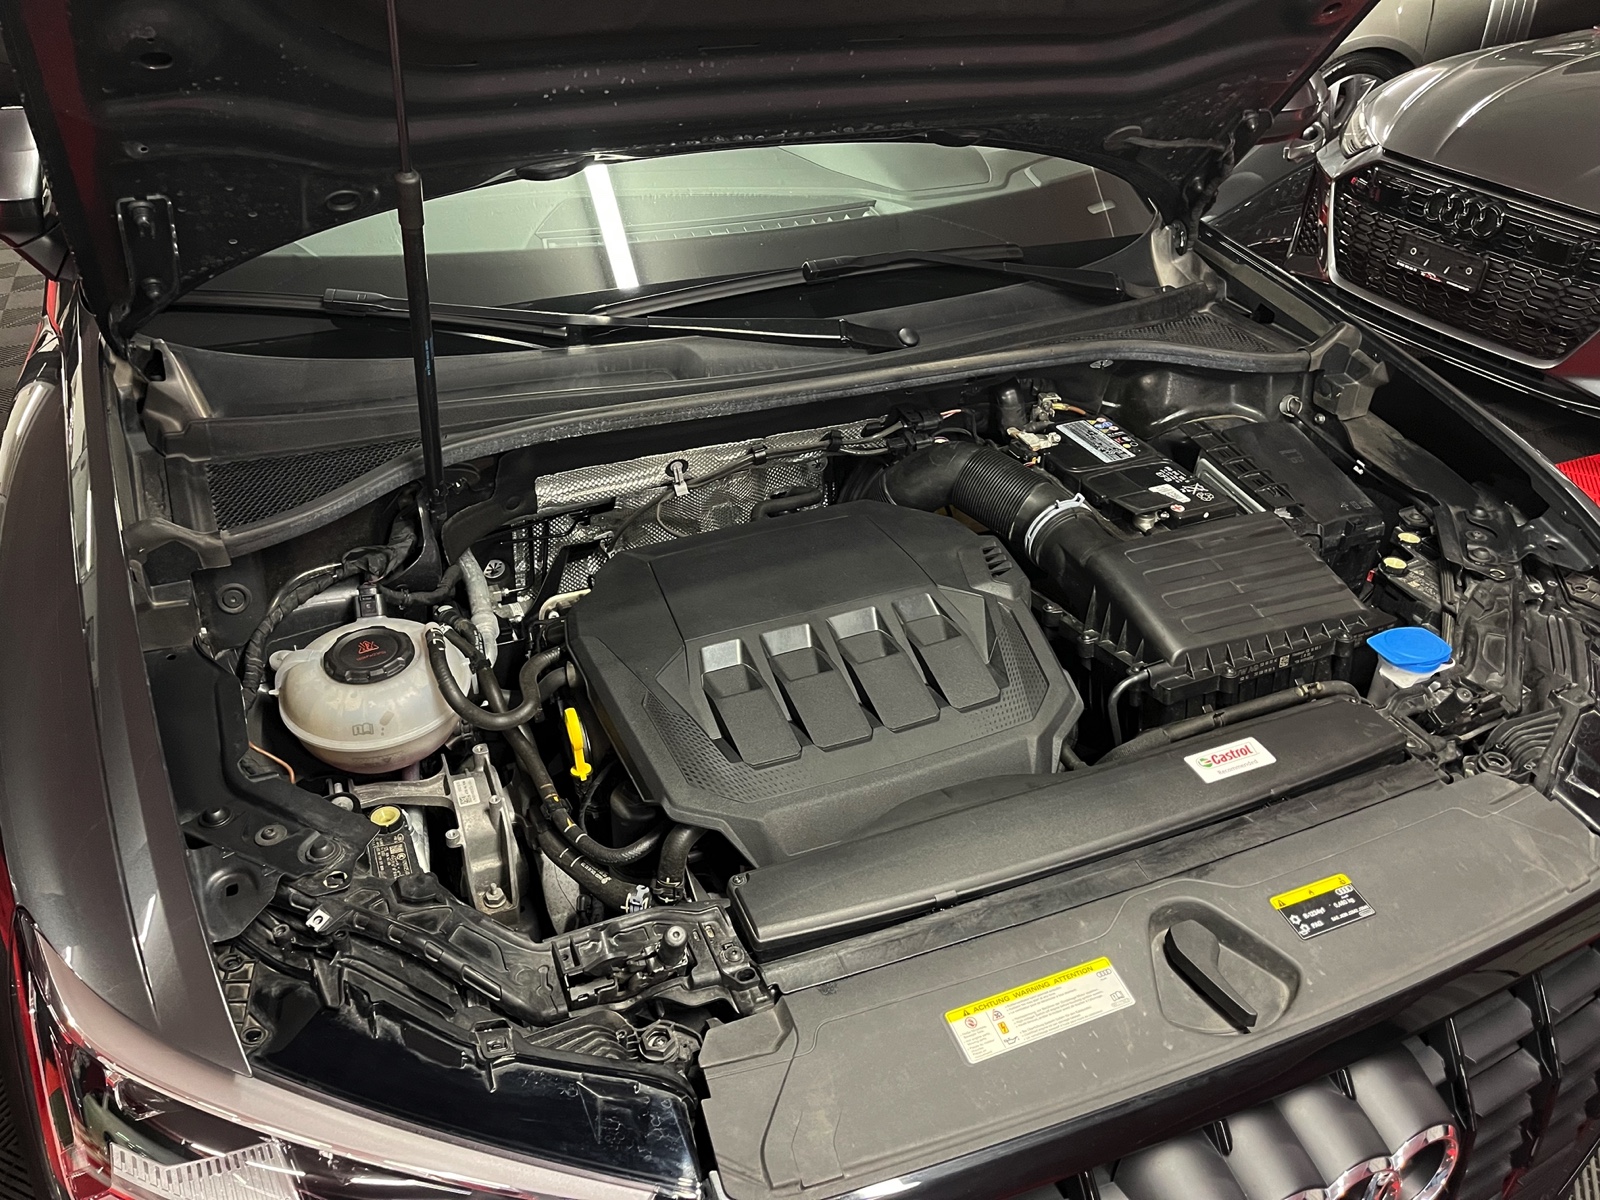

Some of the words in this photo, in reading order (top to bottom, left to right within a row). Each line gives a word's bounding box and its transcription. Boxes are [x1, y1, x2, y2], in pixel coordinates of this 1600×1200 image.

[1211, 744, 1254, 765] Castrol
[1216, 759, 1259, 775] Recommended
[973, 995, 1011, 1014] ACHTUNG
[1012, 981, 1051, 998] WARNING
[1053, 965, 1094, 985] ATTENTION
